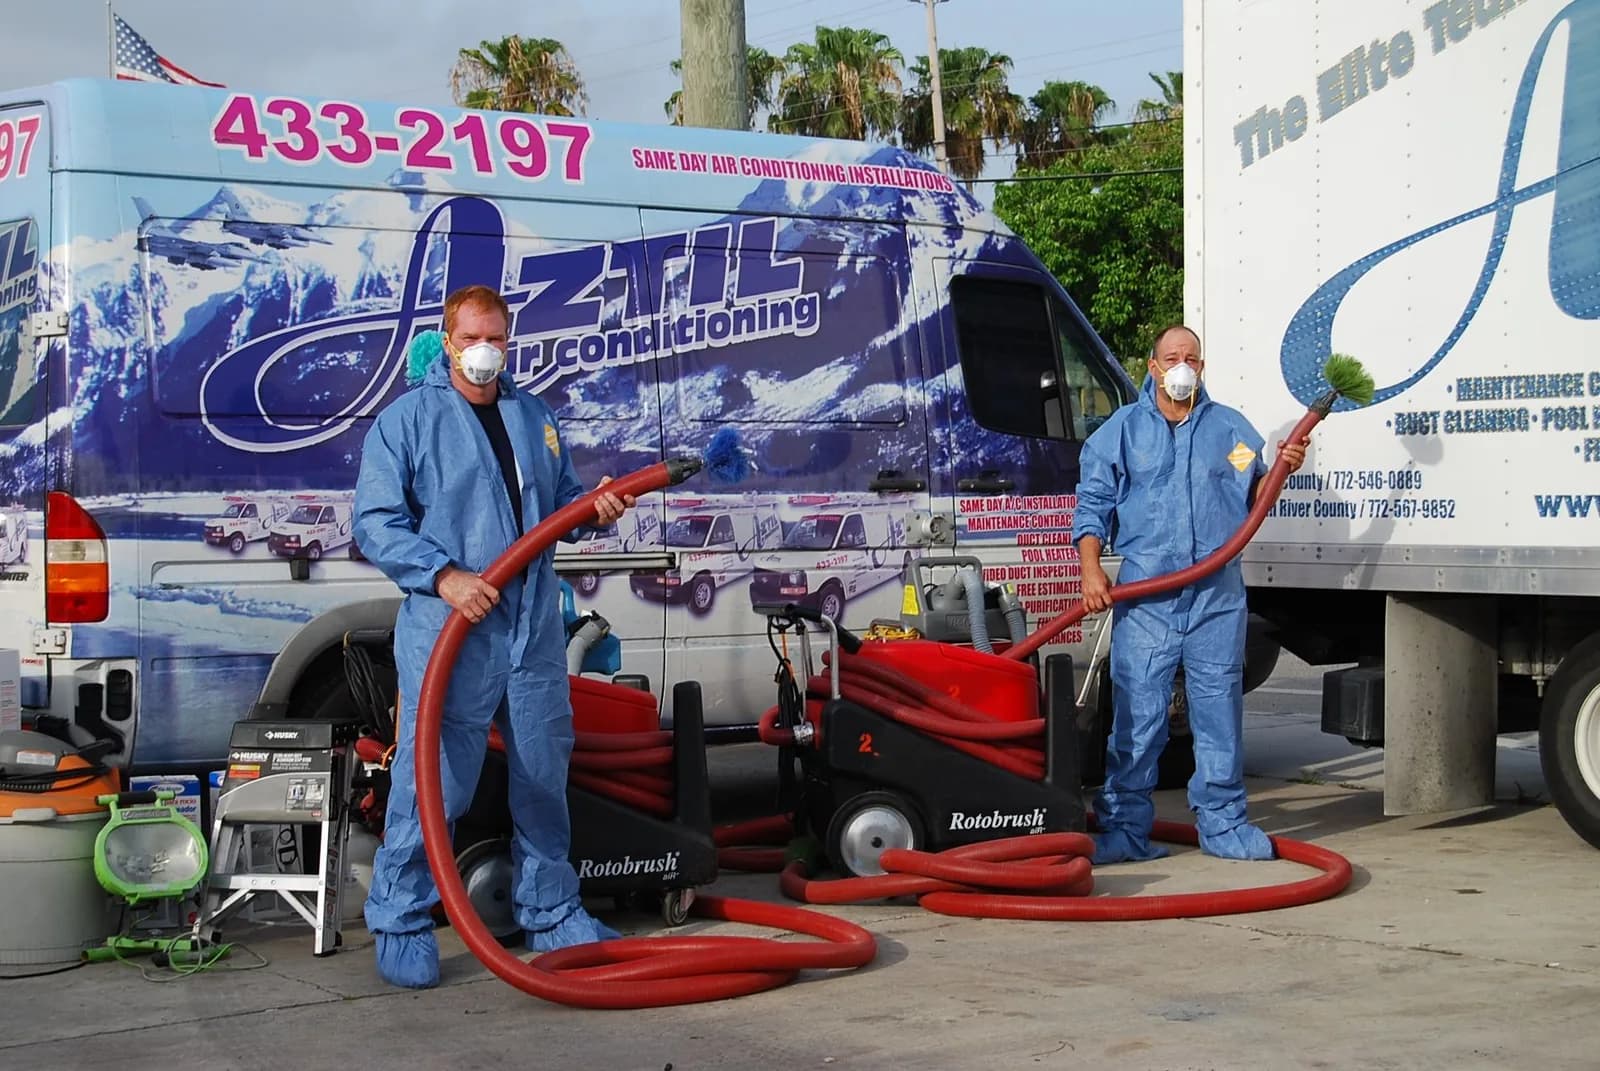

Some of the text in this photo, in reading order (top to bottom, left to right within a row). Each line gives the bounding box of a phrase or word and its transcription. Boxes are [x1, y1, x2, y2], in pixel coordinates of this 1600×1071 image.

[1233, 95, 1308, 169] The
[1316, 30, 1415, 123] Elite
[213, 95, 592, 182] 433-2197
[632, 149, 952, 192] SAME DAY AIR CONDITIONING INSTALLATIONS
[556, 294, 818, 368] conditioning
[1456, 372, 1584, 401] MAINTENANCE
[1395, 411, 1440, 435] DUCT
[1443, 407, 1529, 434] CLEANING
[1542, 405, 1589, 431] POOL
[1334, 470, 1422, 490] 772-546-0889
[960, 496, 1078, 513] SAME DAY A/C INSTALLATIO
[1280, 498, 1311, 517] River
[1313, 498, 1356, 519] County
[1368, 499, 1456, 518] 772-567-9852
[968, 514, 1074, 531] MAINTENANCE CONTRAC
[1017, 534, 1041, 546] DUCT
[1022, 549, 1044, 562] POOL
[1008, 567, 1031, 580] DUCT
[1017, 583, 1036, 597] FREE
[273, 732, 299, 740] HUSKY
[240, 752, 270, 762] HUSKY
